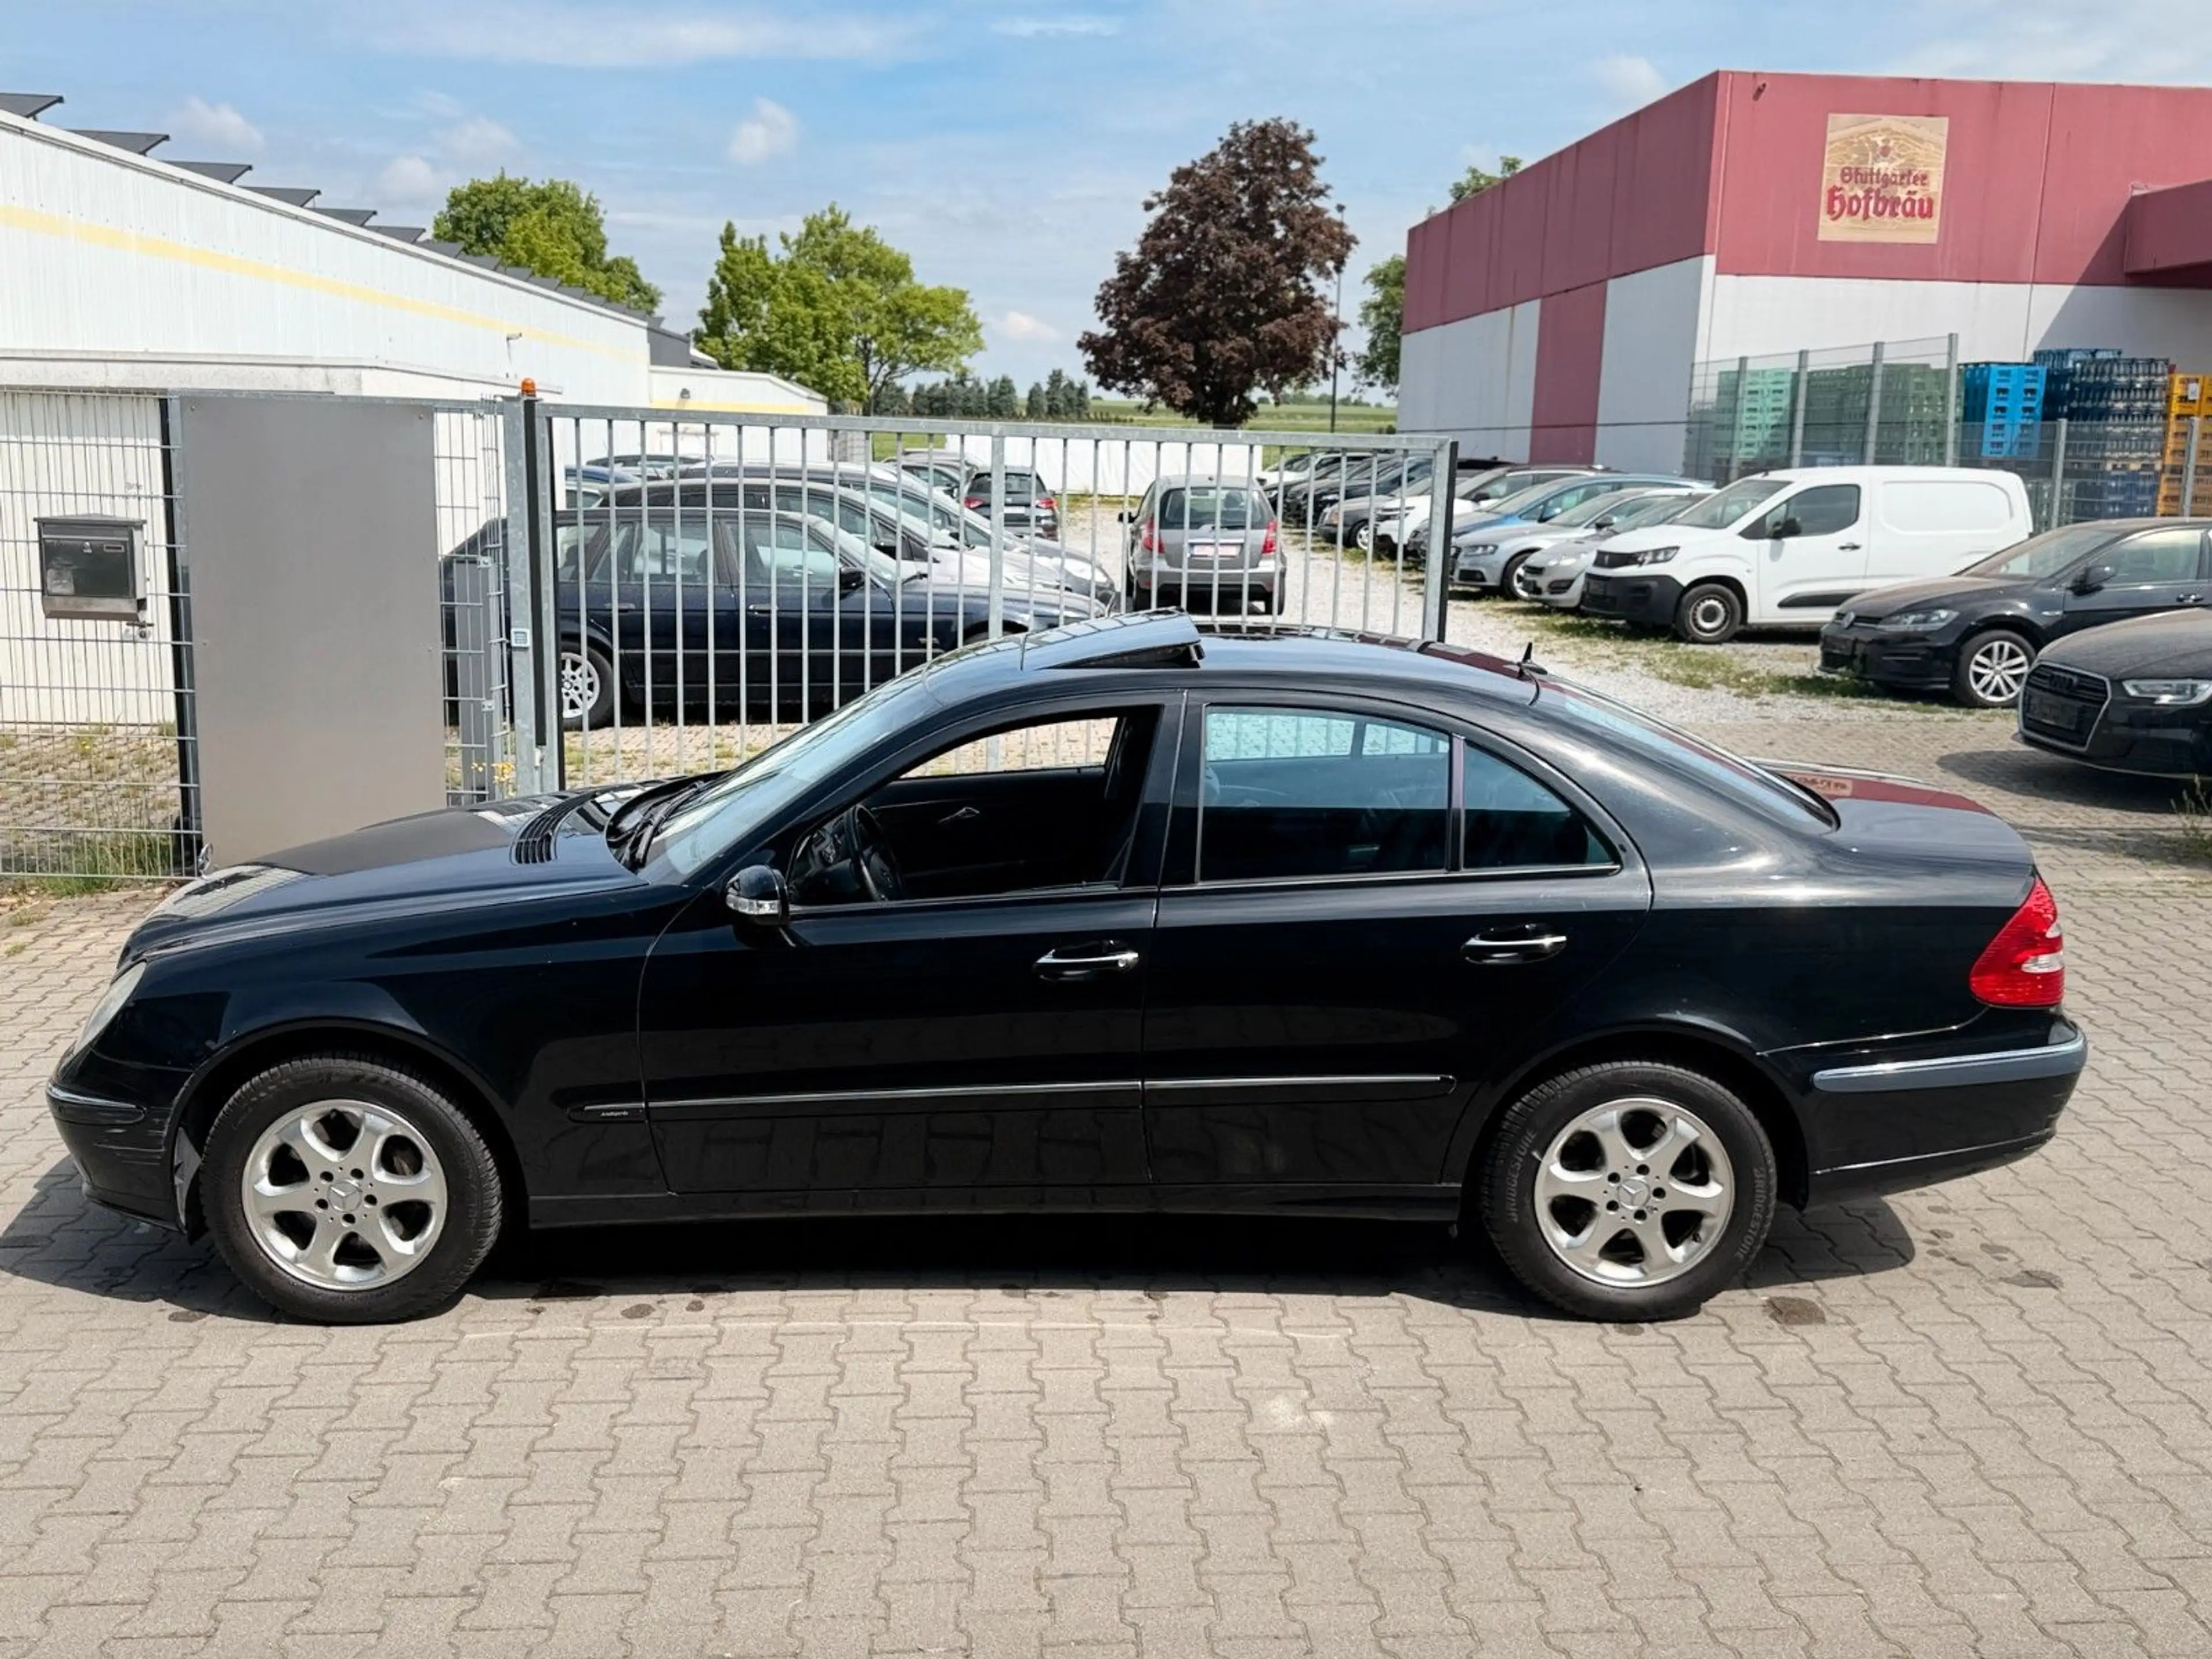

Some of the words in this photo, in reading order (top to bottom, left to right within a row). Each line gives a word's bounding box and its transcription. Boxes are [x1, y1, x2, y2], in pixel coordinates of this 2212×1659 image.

[1840, 166, 1928, 188] Stuttgarter
[1827, 185, 1934, 221] Hofbräu
[1505, 1128, 1537, 1224] BRIDGESTONE
